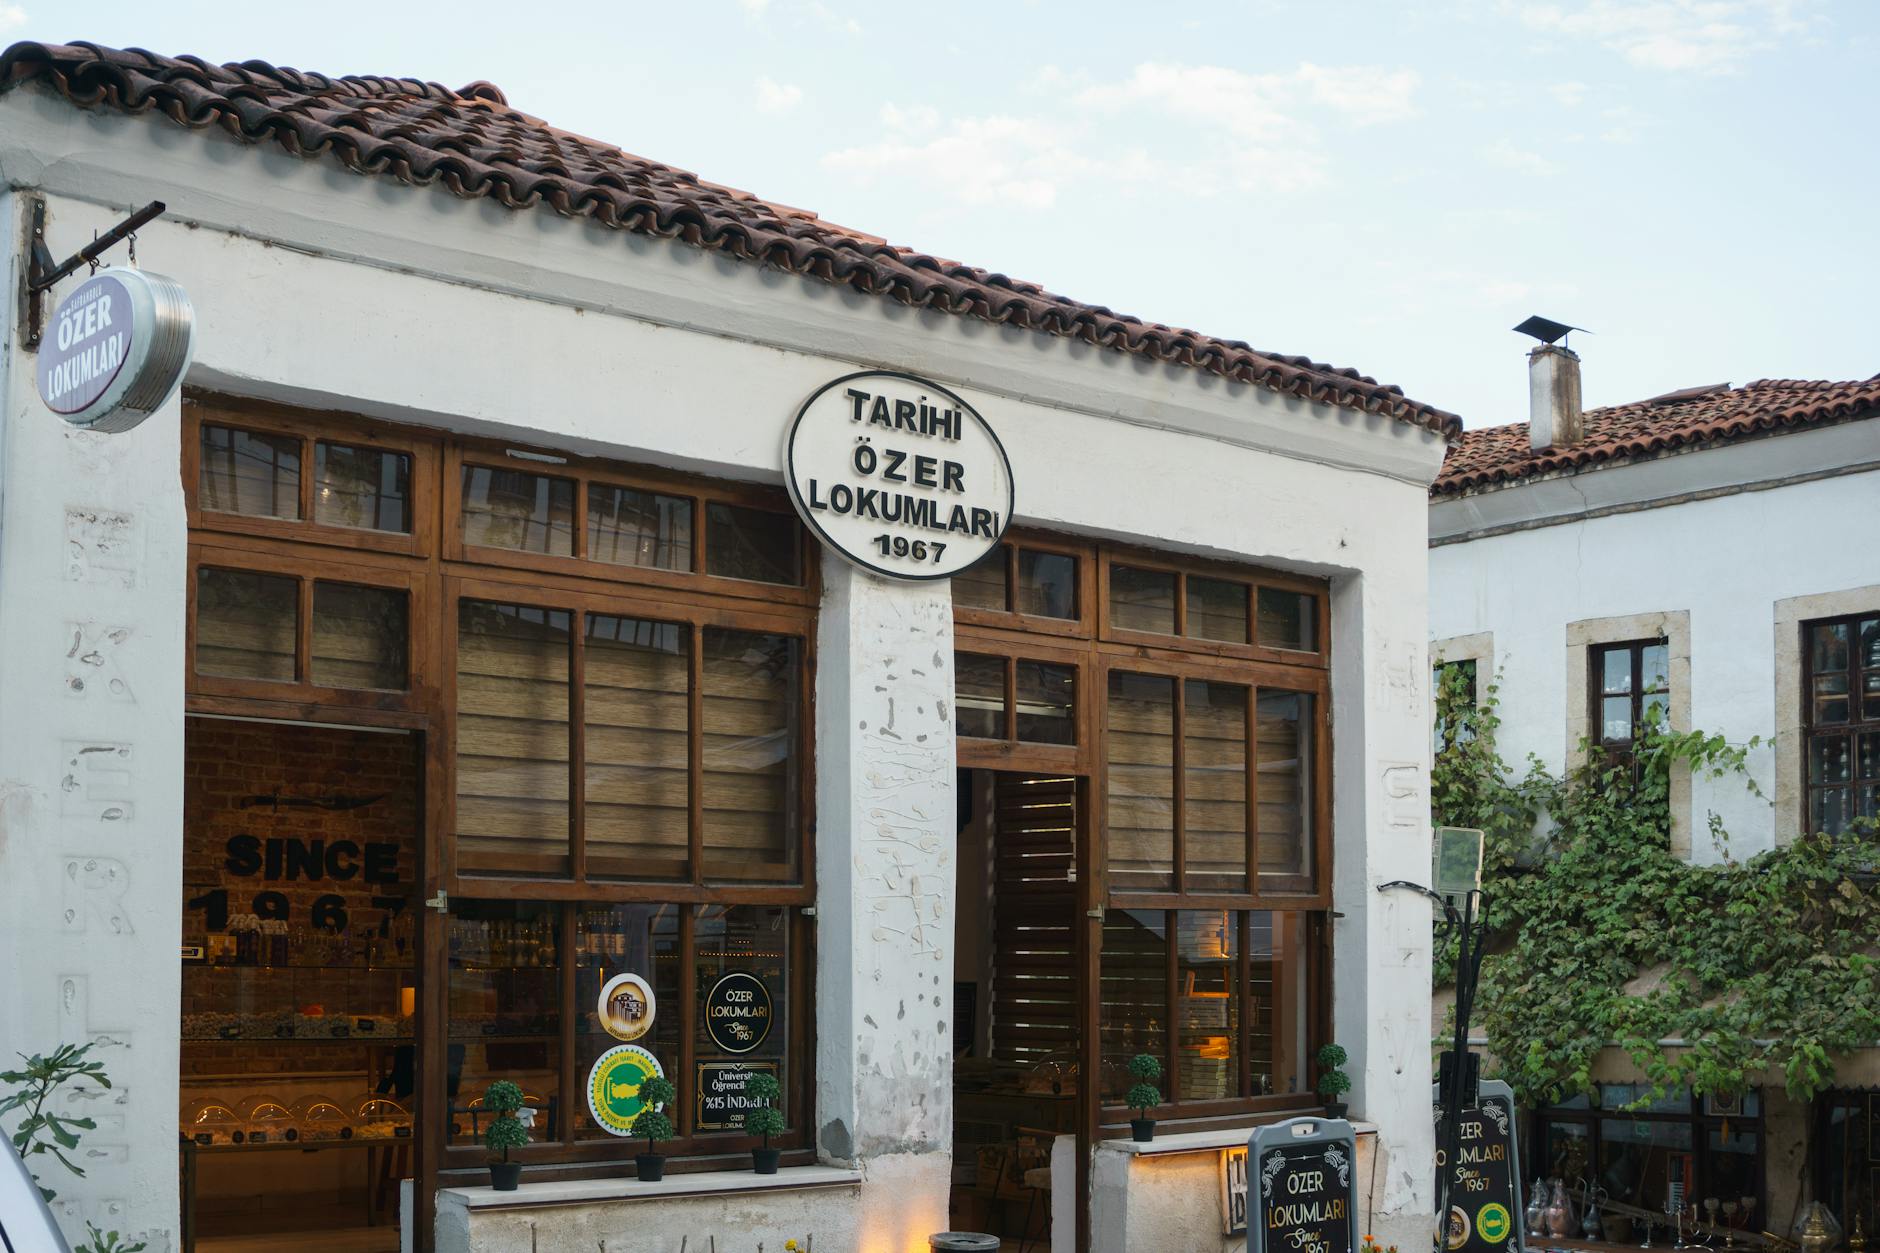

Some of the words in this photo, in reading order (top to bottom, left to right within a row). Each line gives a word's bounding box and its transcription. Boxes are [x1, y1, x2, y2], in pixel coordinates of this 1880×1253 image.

[58, 295, 113, 351] ÖZER
[48, 332, 123, 401] LOKUMLARI
[847, 388, 962, 440] TARİHİ
[854, 436, 965, 492] ÖZER
[872, 534, 947, 563] 1967
[224, 834, 400, 884] SINCE
[188, 889, 408, 938] 1967
[726, 988, 753, 1003] ÖZER
[711, 1006, 768, 1018] LOKUMLARI
[723, 1021, 749, 1034] Since
[736, 1030, 753, 1041] 1967
[712, 1079, 745, 1092] Öğrencil
[719, 1070, 753, 1081] Üniversi
[705, 1096, 724, 1109] %15
[1460, 1121, 1483, 1140] ZER
[1435, 1144, 1505, 1167] OUMLARI
[1287, 1170, 1324, 1194] ÖZER
[1455, 1167, 1480, 1183] Since
[1465, 1178, 1490, 1192] 1967
[1269, 1199, 1345, 1229] LOKUMLARI
[1284, 1228, 1320, 1249] Since
[1304, 1241, 1330, 1253] 1967
